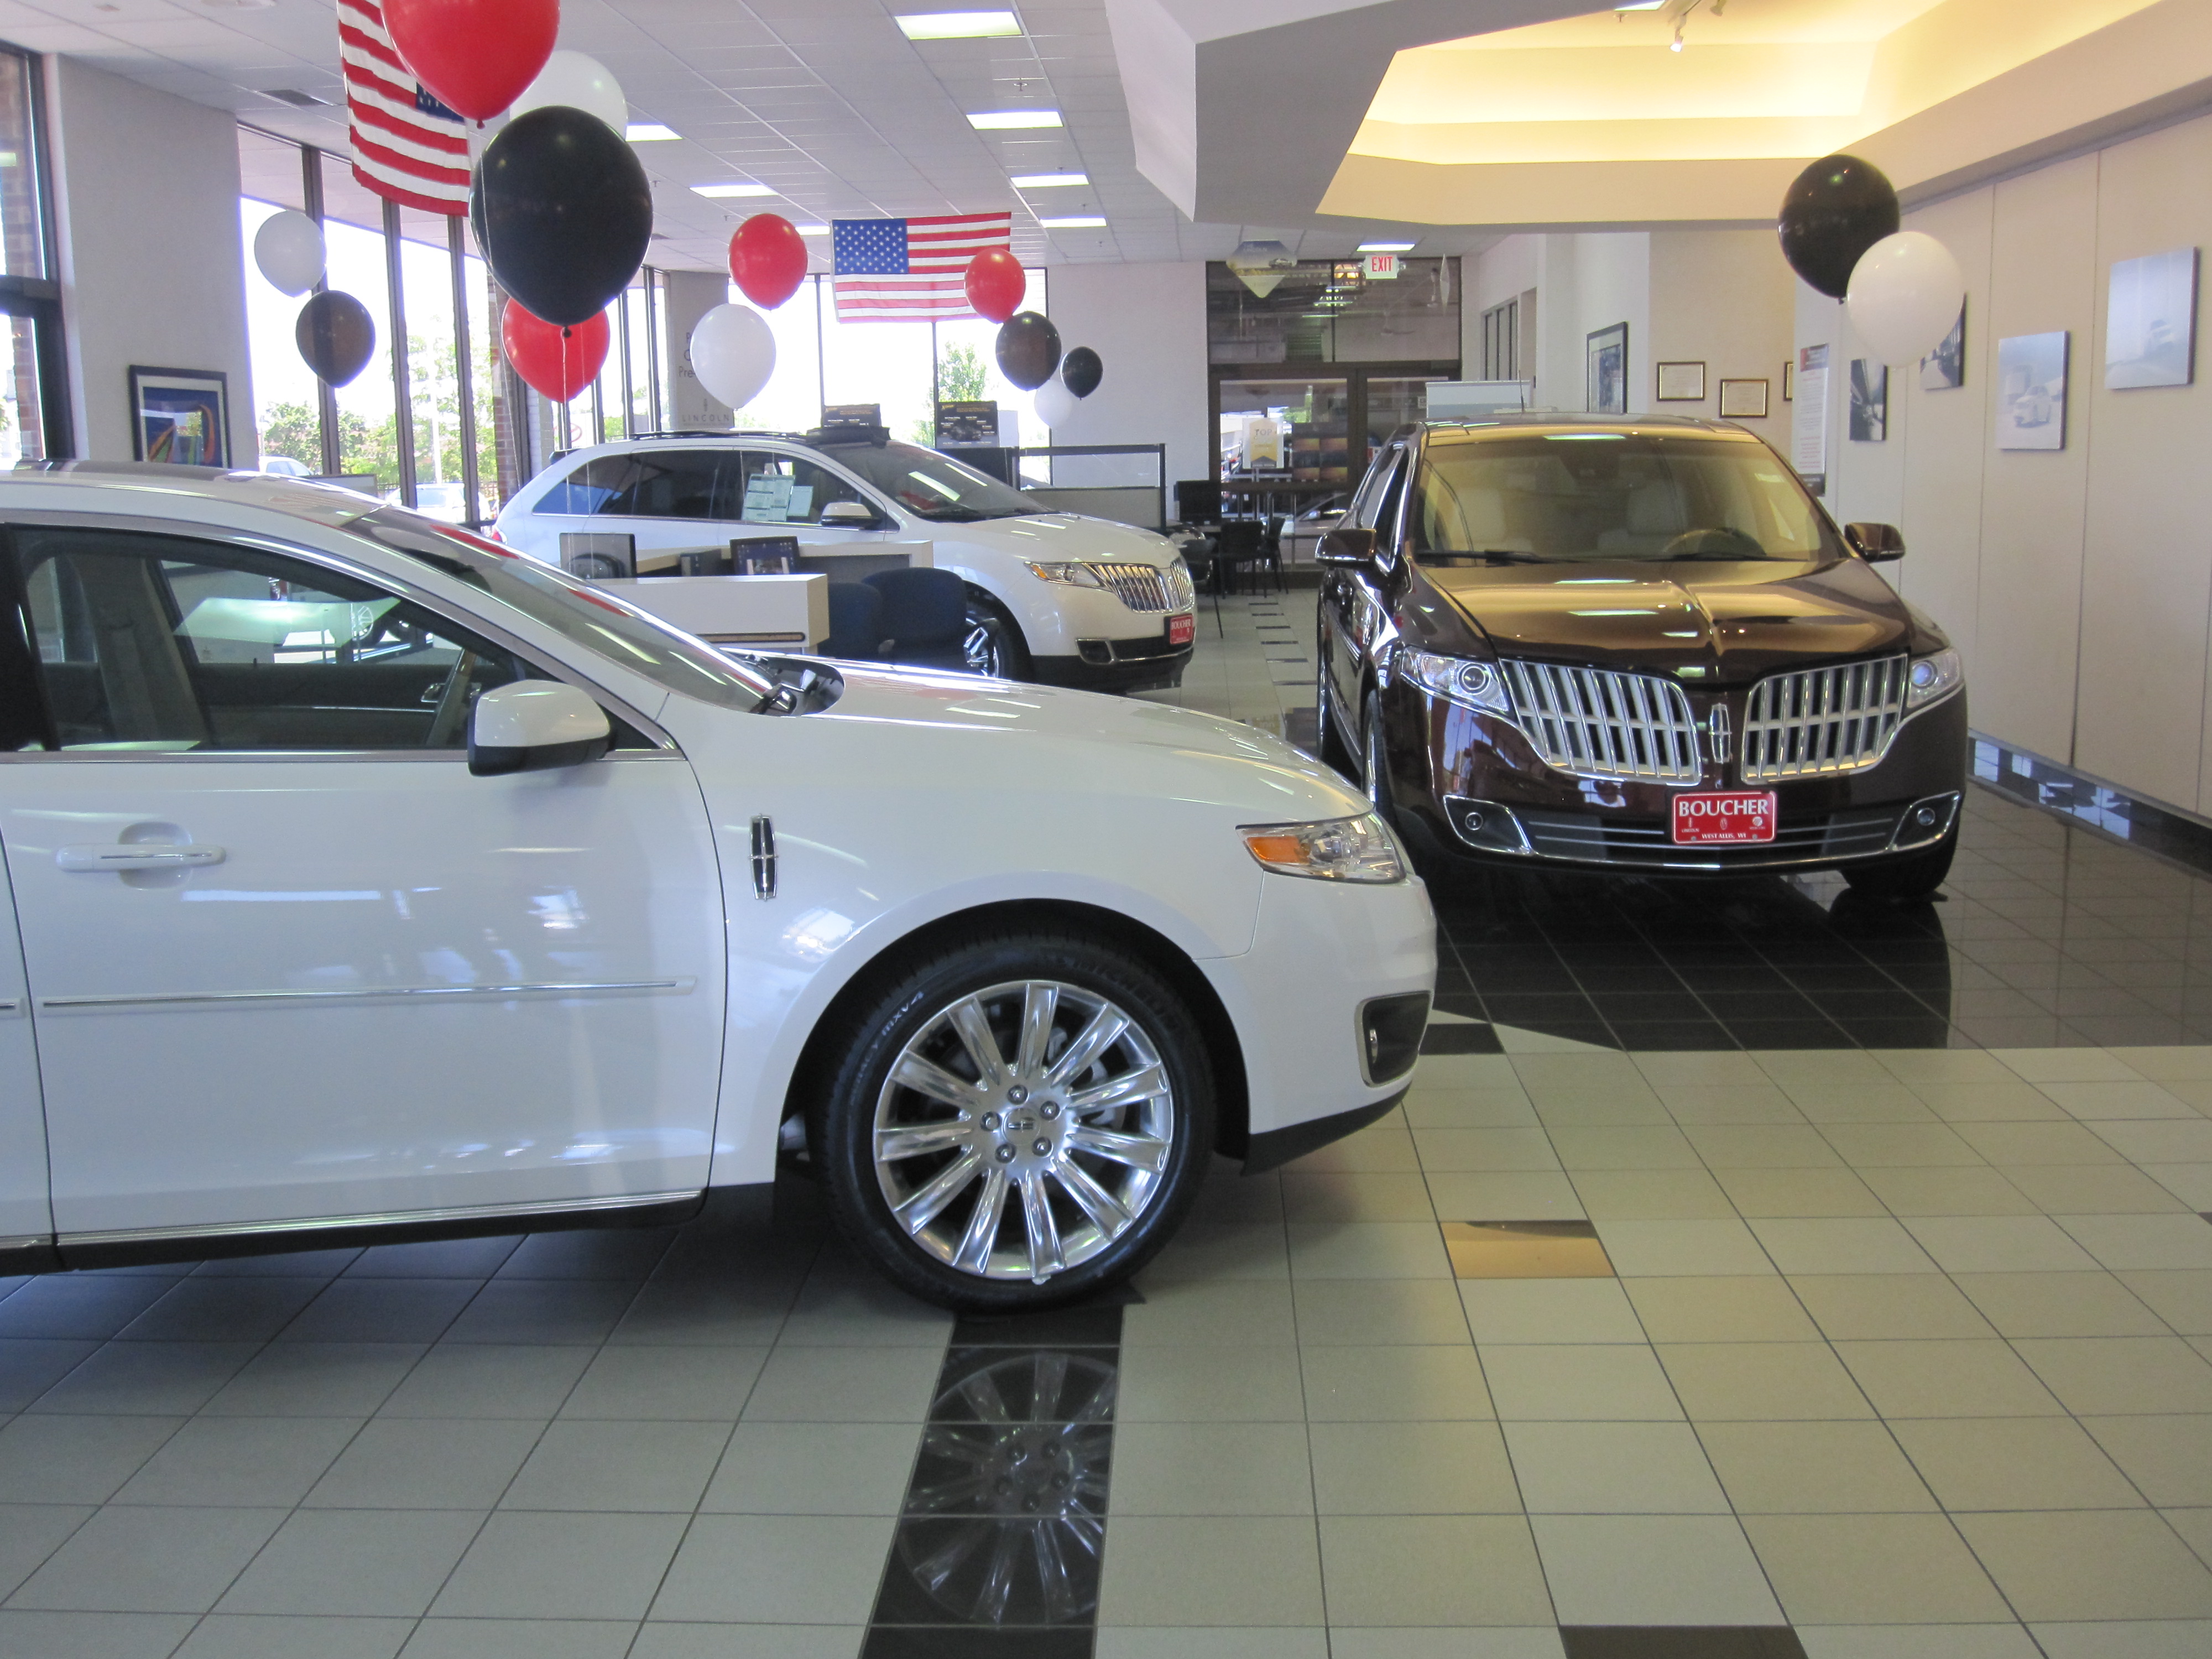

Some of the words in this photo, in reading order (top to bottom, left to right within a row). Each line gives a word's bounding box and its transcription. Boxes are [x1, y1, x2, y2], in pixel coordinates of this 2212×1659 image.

[1371, 257, 1394, 272] EXIT
[682, 414, 729, 422] LINCOLN
[1171, 619, 1191, 630] BOUCHER
[1679, 800, 1768, 816] BOUCHER
